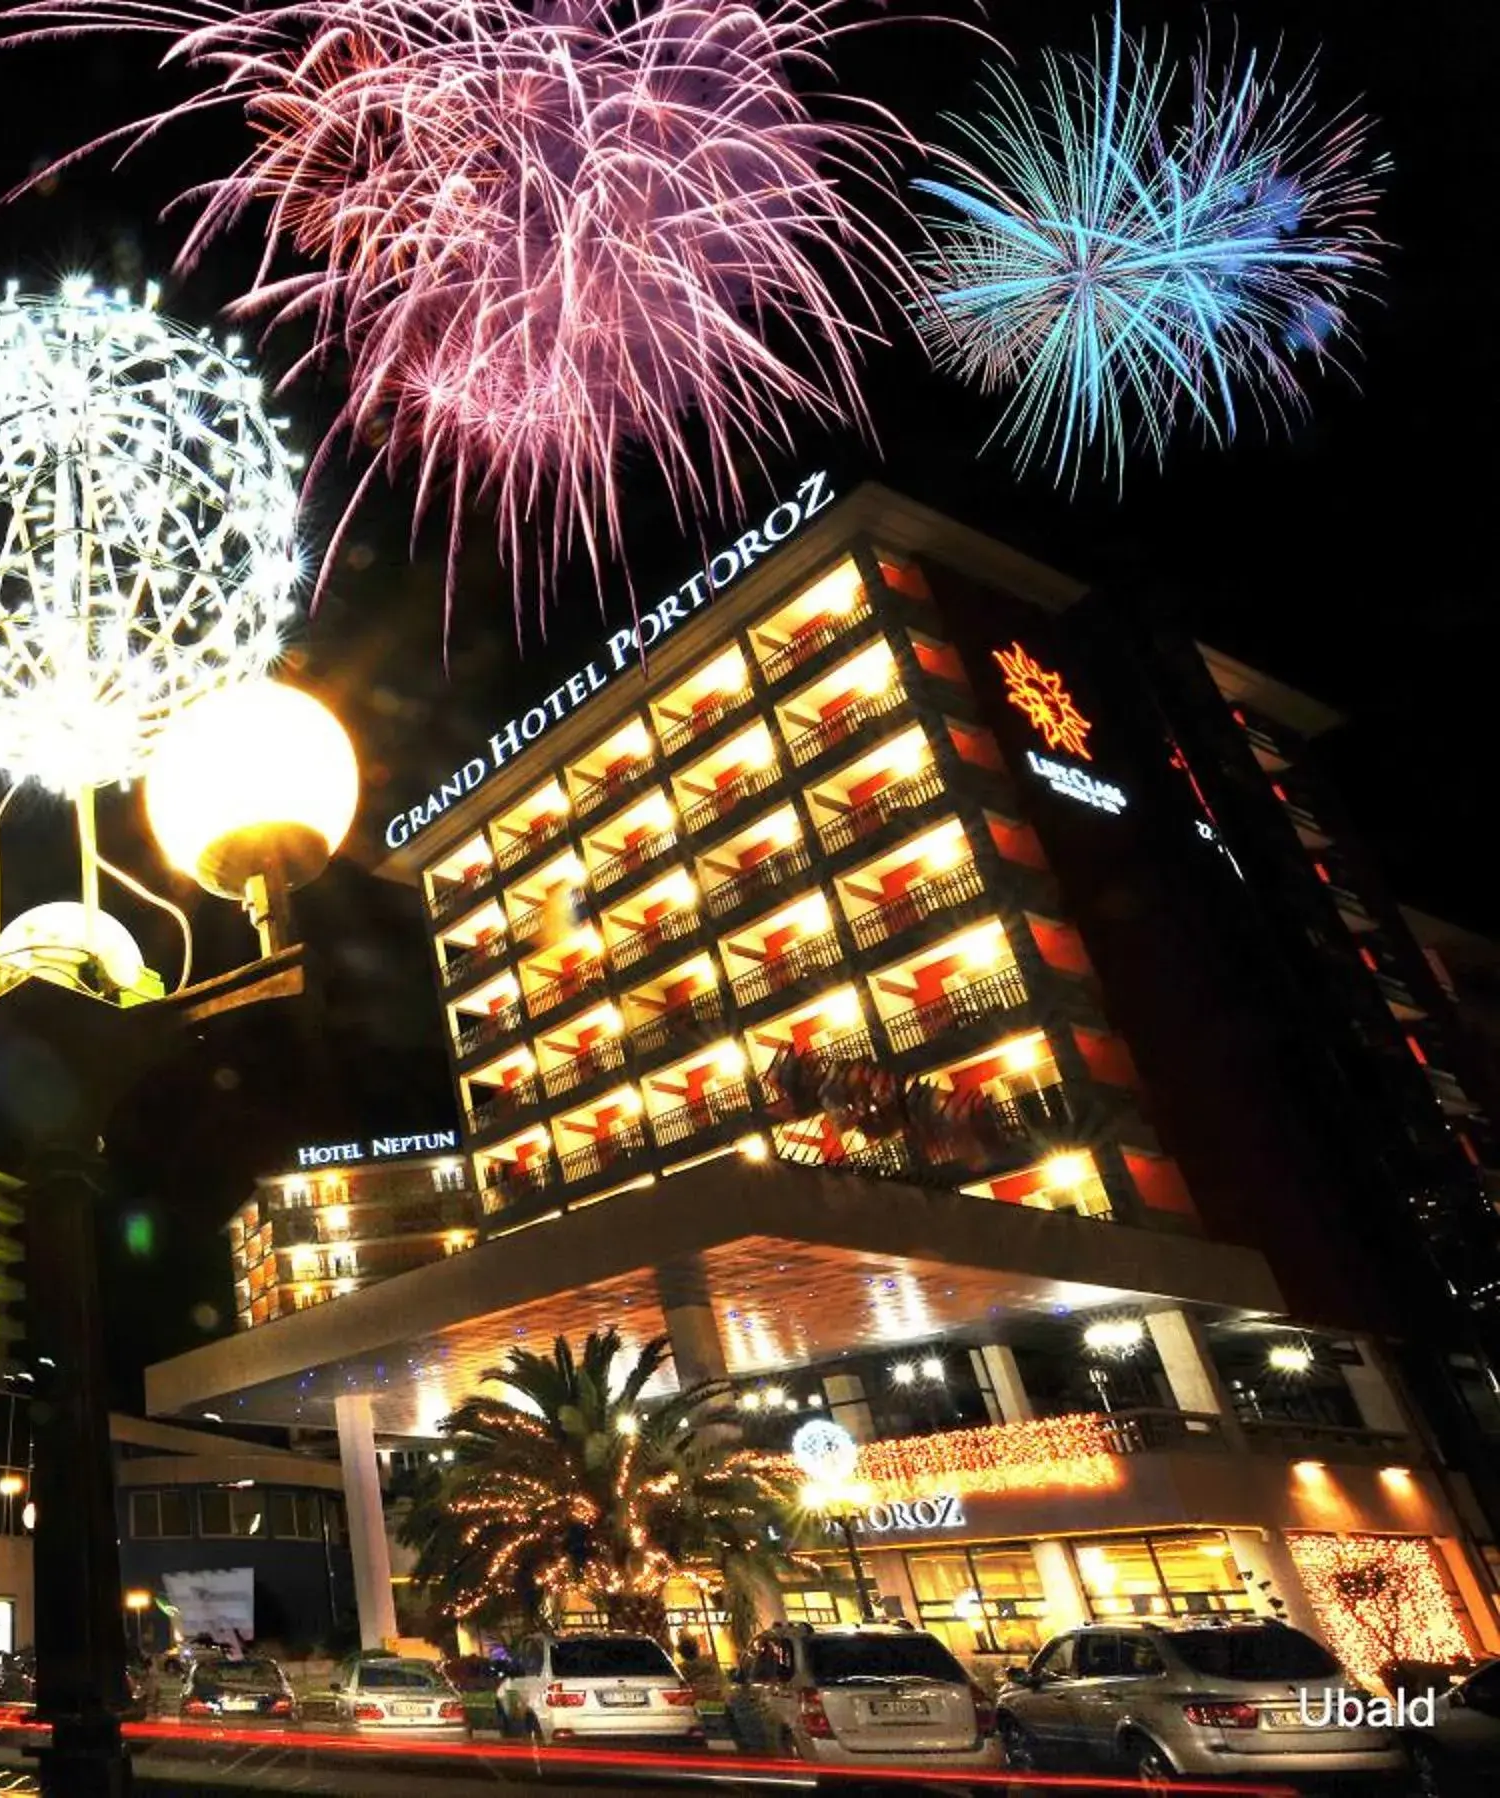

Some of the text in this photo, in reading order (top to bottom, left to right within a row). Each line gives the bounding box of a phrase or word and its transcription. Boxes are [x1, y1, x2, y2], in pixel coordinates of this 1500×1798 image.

[385, 469, 836, 849] GRAND HOTEL PORTOROŽ
[298, 1130, 456, 1166] HOTEL NEPTUN
